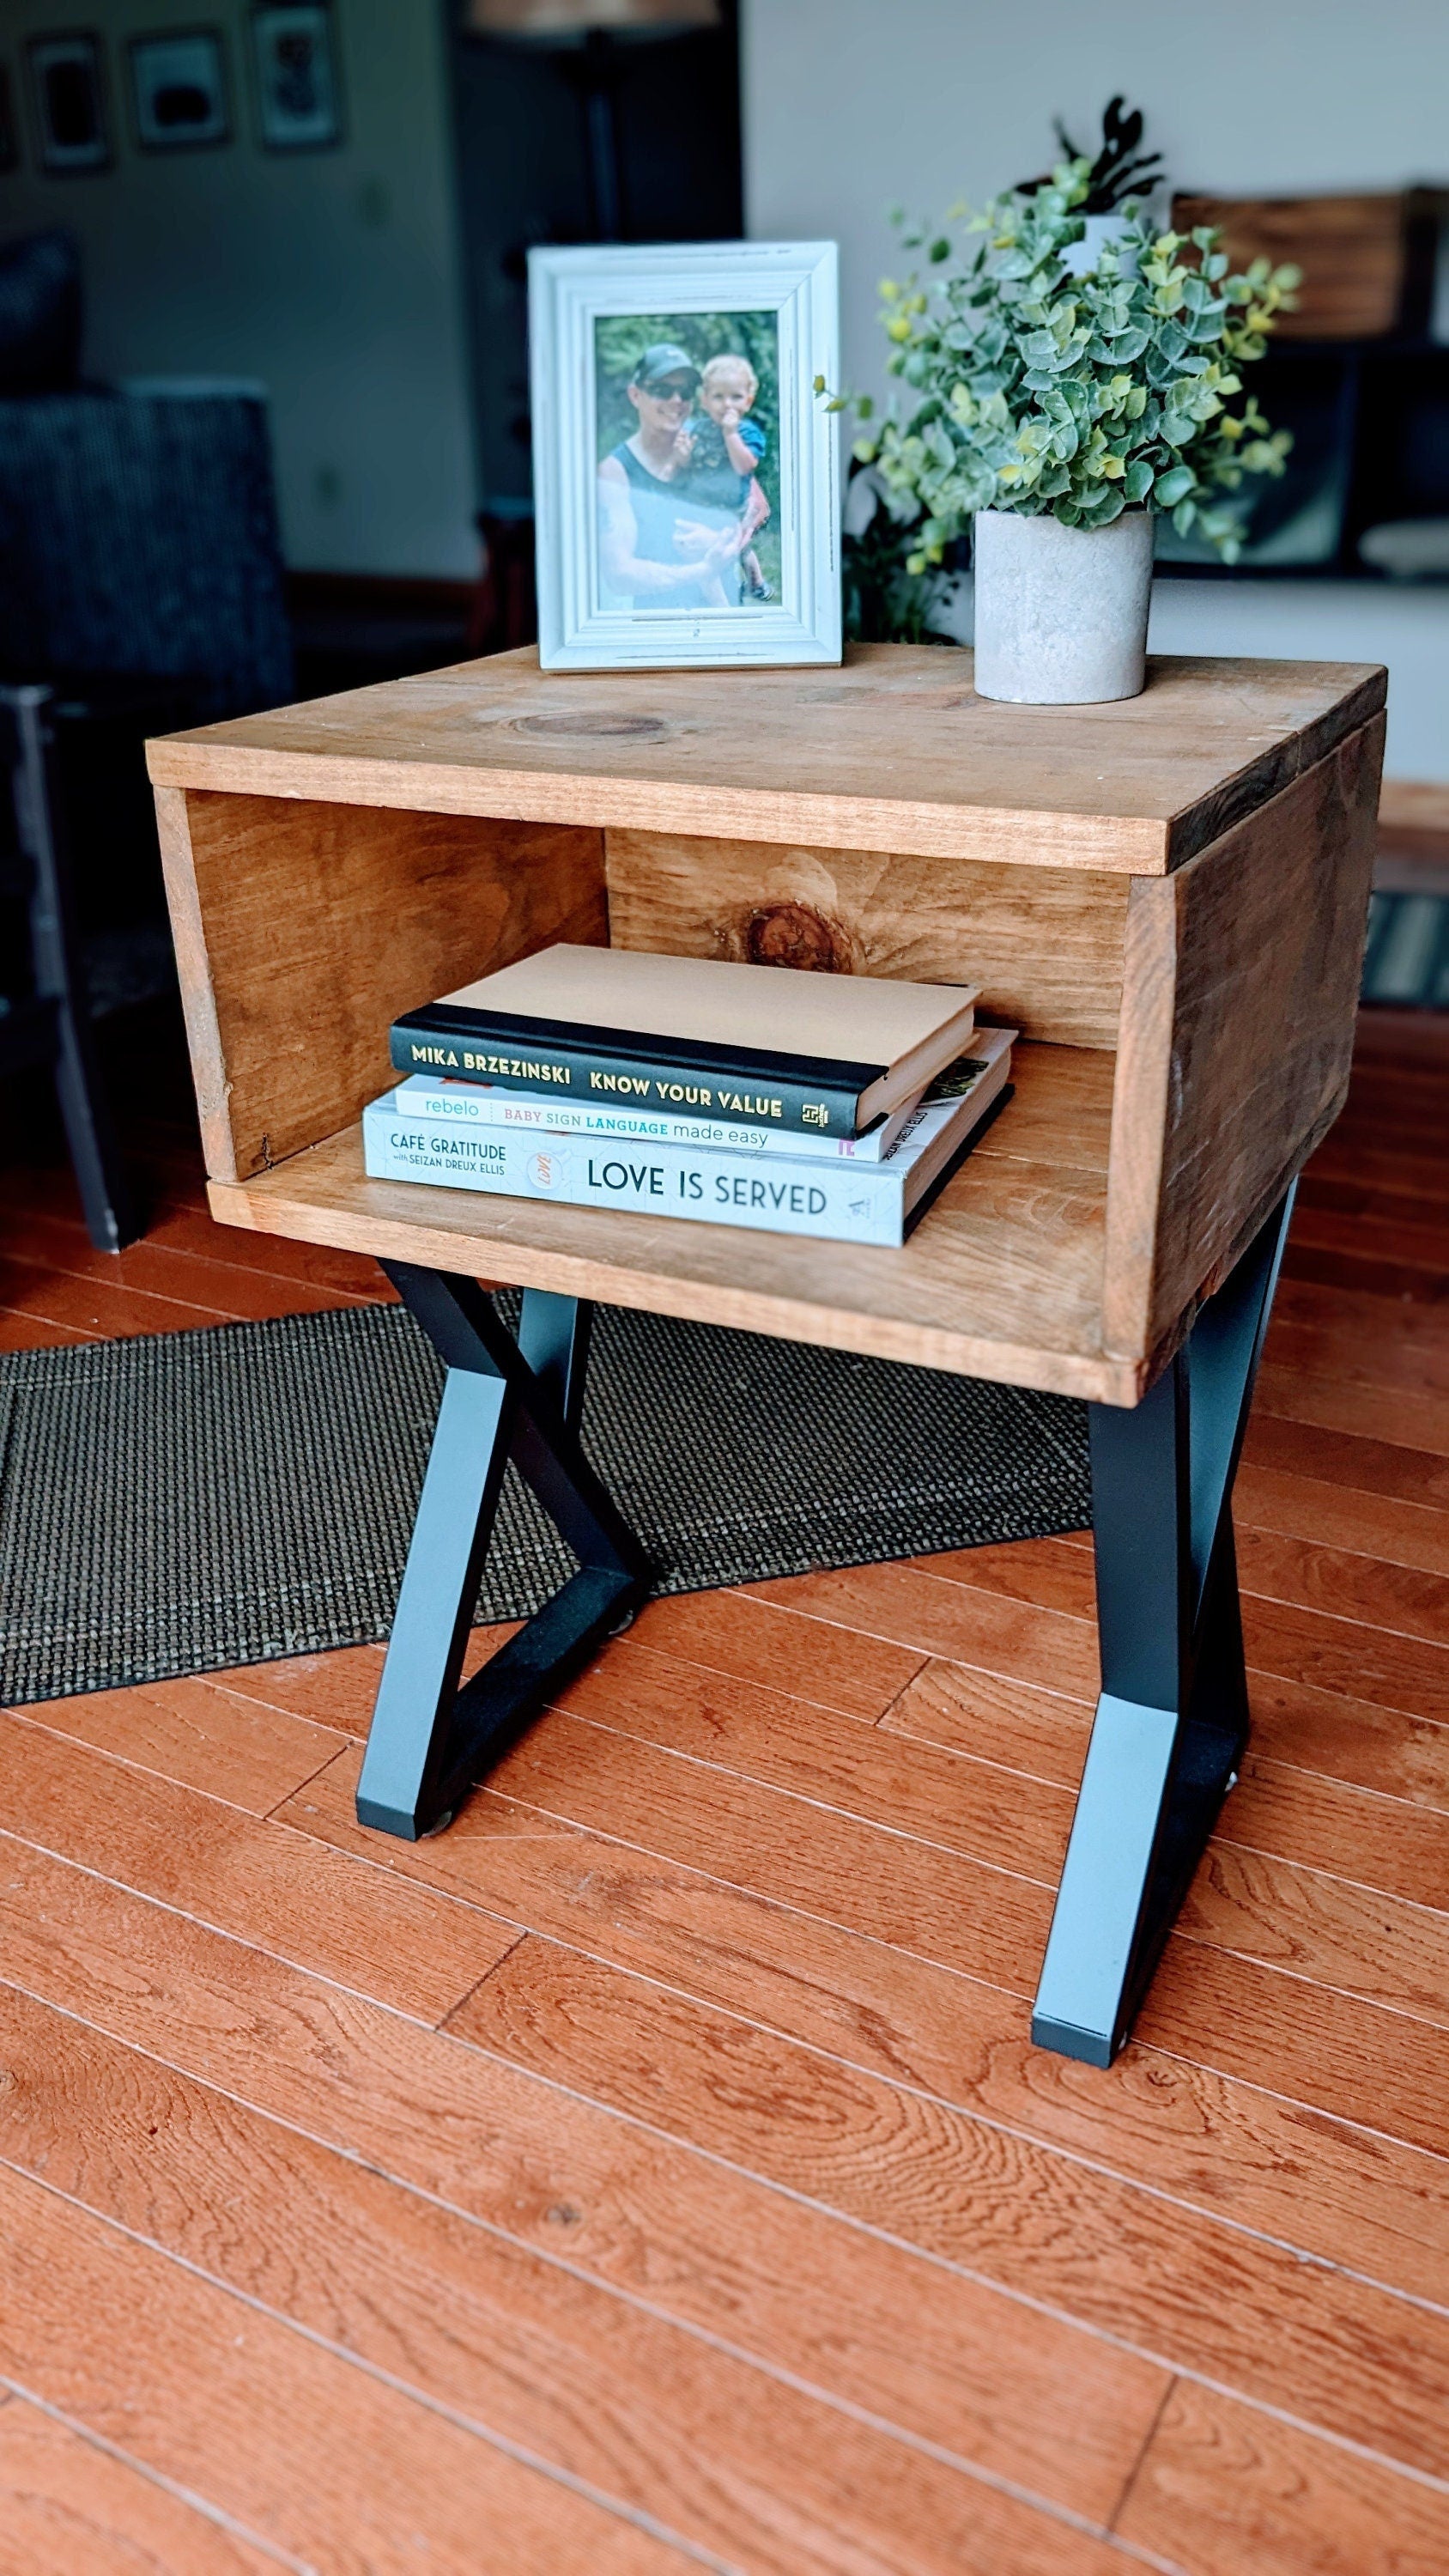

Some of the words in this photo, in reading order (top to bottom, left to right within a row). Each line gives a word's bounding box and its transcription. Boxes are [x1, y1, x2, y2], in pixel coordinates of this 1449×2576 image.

[411, 1044, 459, 1067] MIKA
[464, 1052, 571, 1084] BRZEZINSKI
[590, 1072, 650, 1097] KNOW
[656, 1082, 712, 1107] YOUR
[718, 1092, 782, 1118] VALUE
[426, 1098, 479, 1116] rebelo
[505, 1109, 542, 1122] BABY
[546, 1113, 581, 1127] SIGN
[586, 1116, 668, 1135] LANGUAGE
[674, 1123, 723, 1140] made
[729, 1130, 768, 1148] easy
[391, 1133, 425, 1151] CAFÉ
[431, 1138, 506, 1161] GRATITUDE
[409, 1155, 442, 1167] SEIZAN
[446, 1159, 476, 1172] DREUX
[480, 1163, 505, 1176] ELLIS
[588, 1159, 664, 1195] LOVE
[679, 1170, 703, 1199] IS
[715, 1176, 827, 1214] SERVED
